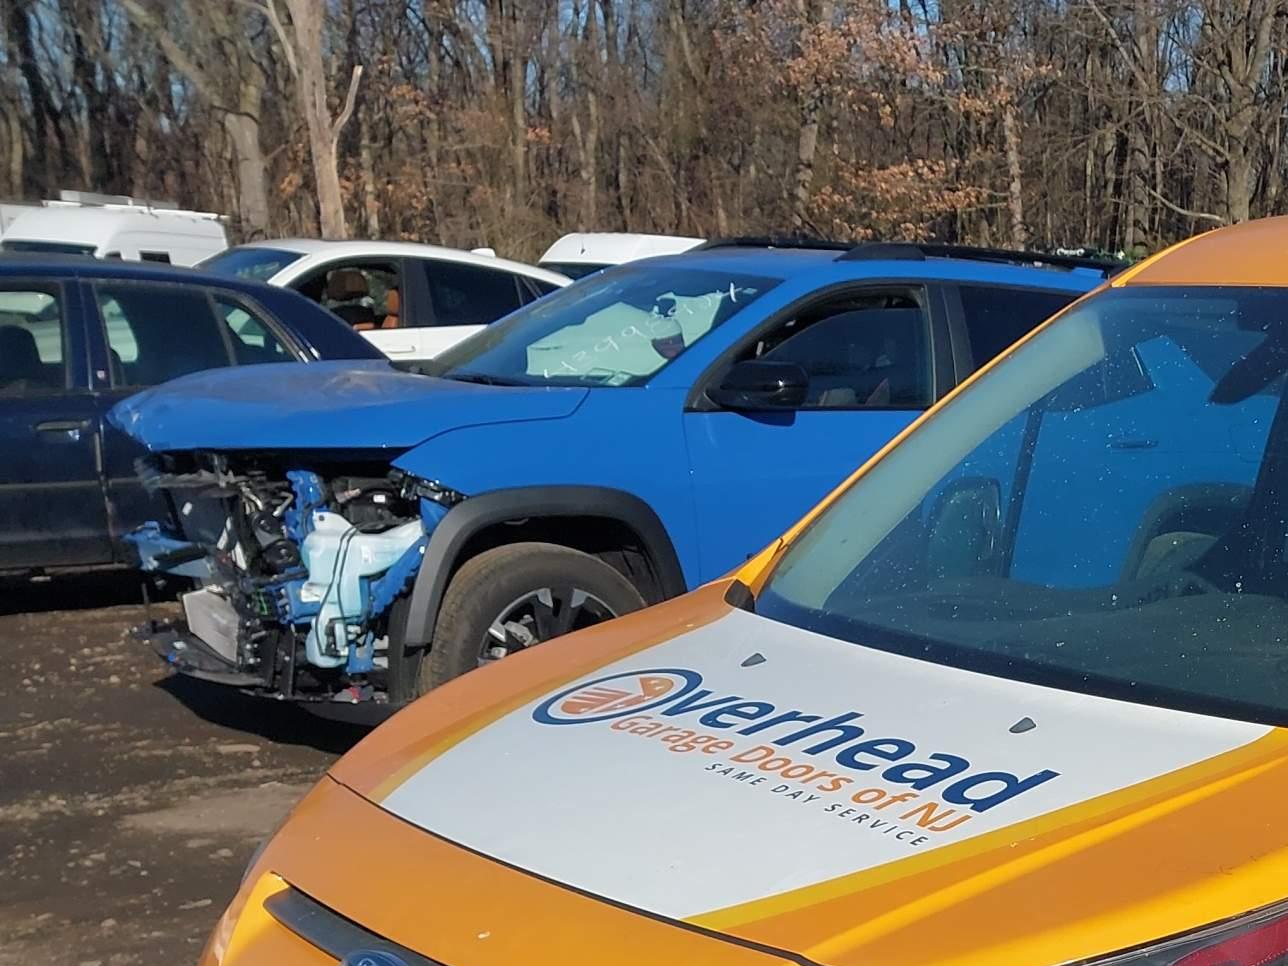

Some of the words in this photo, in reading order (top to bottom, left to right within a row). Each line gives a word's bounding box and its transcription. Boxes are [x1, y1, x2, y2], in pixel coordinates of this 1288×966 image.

[609, 715, 735, 754] Garage
[729, 744, 855, 792] Doors
[851, 787, 919, 811] of
[898, 801, 973, 832] NJ
[705, 762, 768, 786] SAME
[771, 784, 820, 804] DAY
[824, 803, 929, 847] SERVICE
